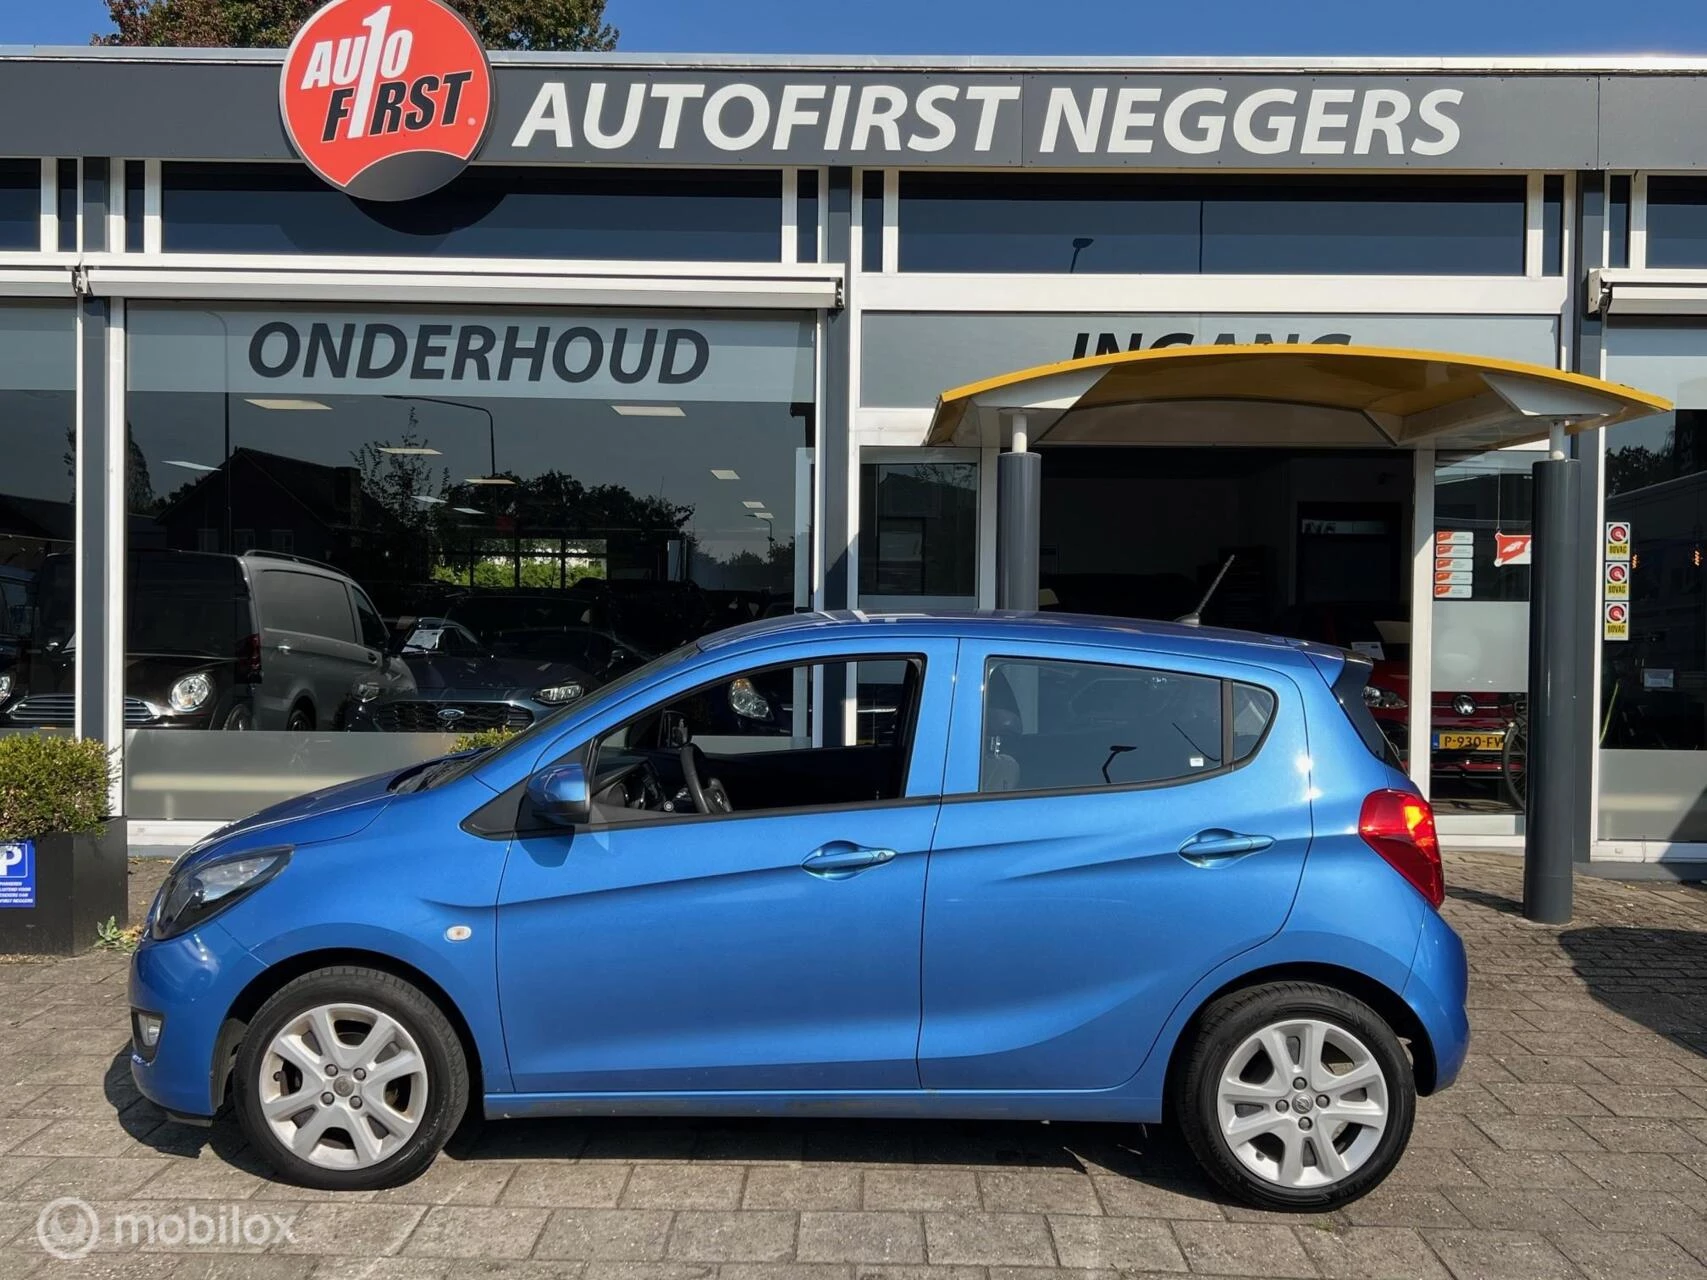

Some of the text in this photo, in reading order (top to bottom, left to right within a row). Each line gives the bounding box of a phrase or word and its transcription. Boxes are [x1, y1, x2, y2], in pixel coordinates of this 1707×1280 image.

[511, 82, 1465, 156] AUTOFIRST NEGGERS
[248, 321, 710, 385] ONDERHOUD
[1609, 545, 1627, 554] BOVAG
[1608, 585, 1626, 594] BOVAG
[1607, 625, 1625, 634] BOVAG
[0, 844, 23, 876] P
